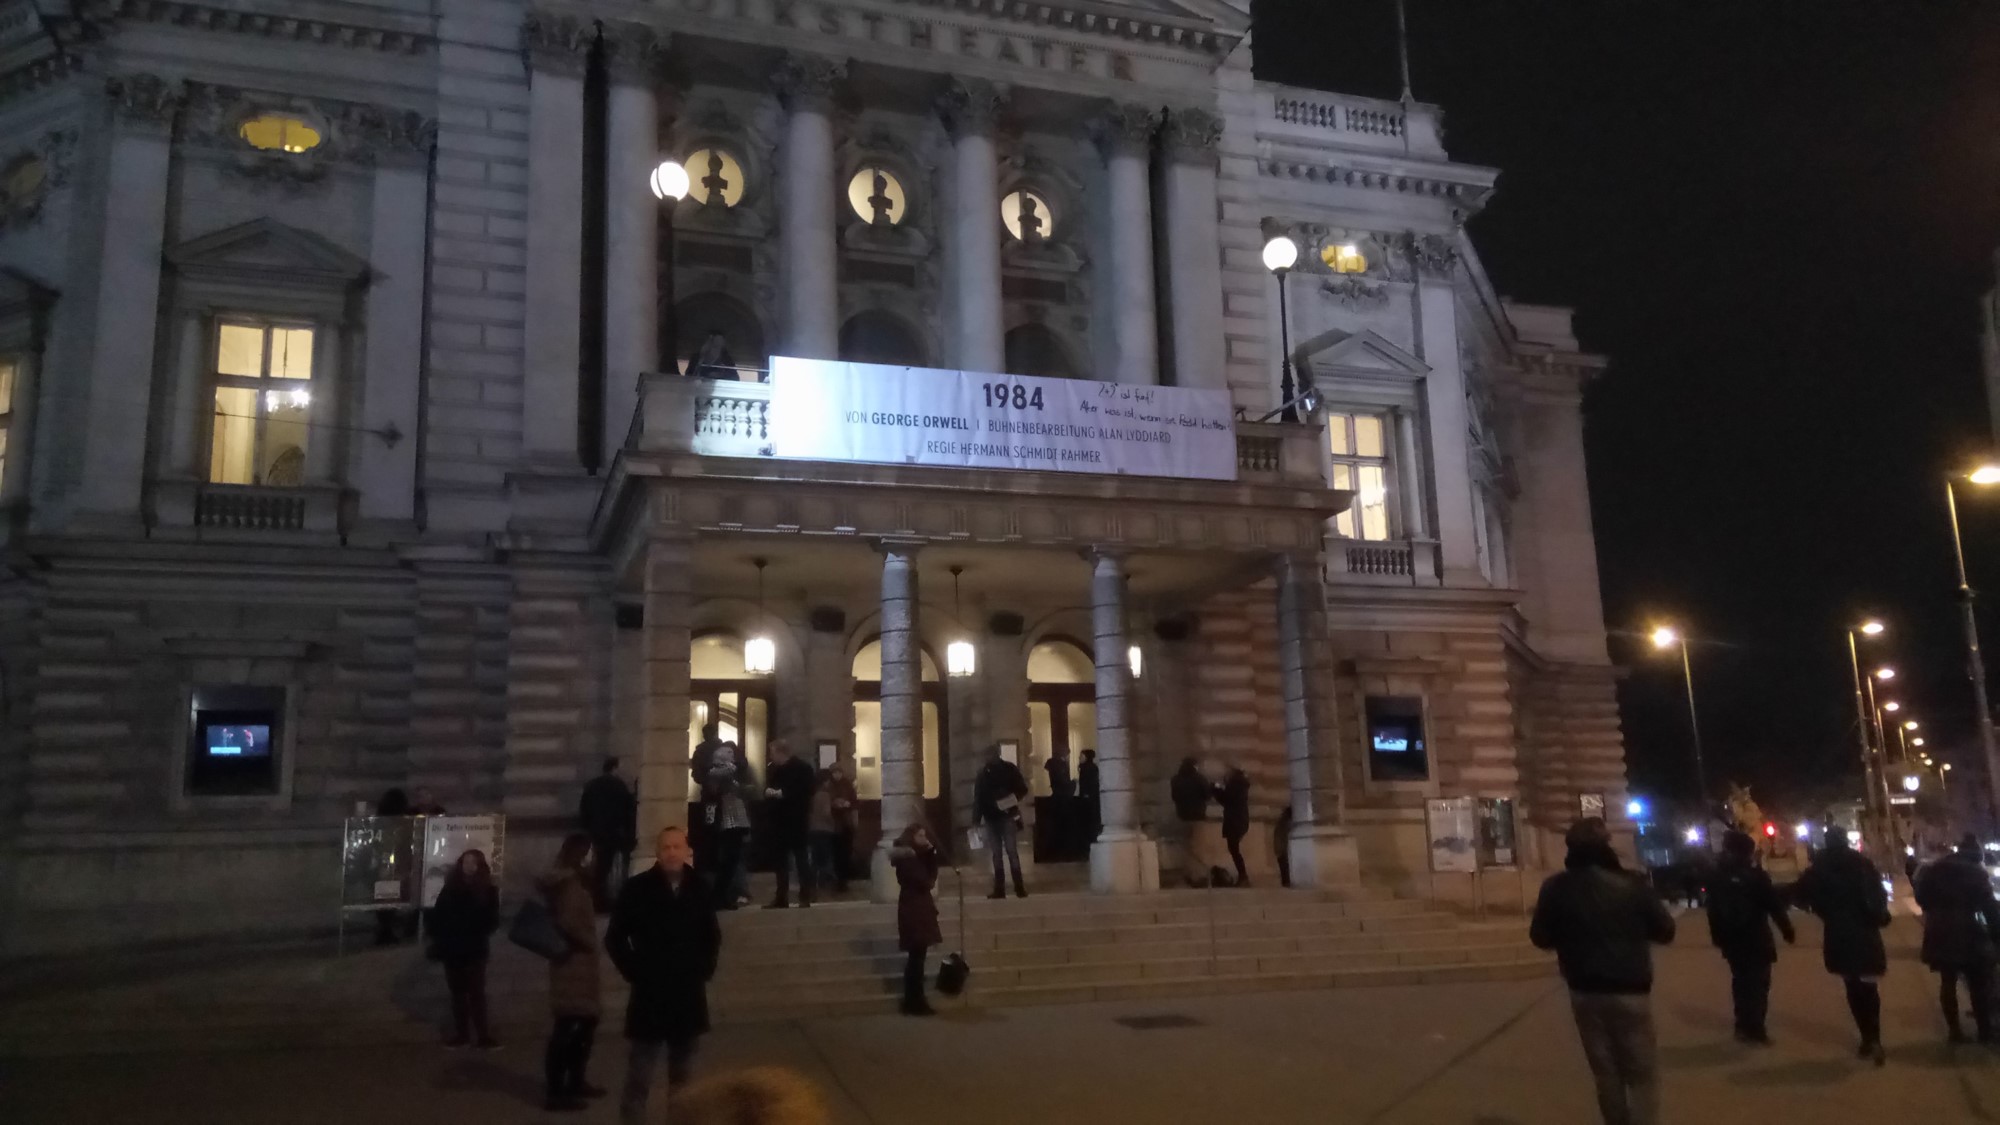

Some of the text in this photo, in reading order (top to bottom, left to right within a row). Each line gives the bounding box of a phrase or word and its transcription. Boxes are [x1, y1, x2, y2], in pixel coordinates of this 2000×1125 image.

[982, 382, 1045, 411] 1984
[845, 411, 867, 424] VON
[871, 412, 919, 427] GEORGE
[923, 416, 969, 430] ORWELL
[1099, 429, 1123, 441] ALAN
[1126, 429, 1171, 444] LYDDIARD
[927, 441, 957, 455] REGIE
[960, 443, 1011, 457] HERMANN
